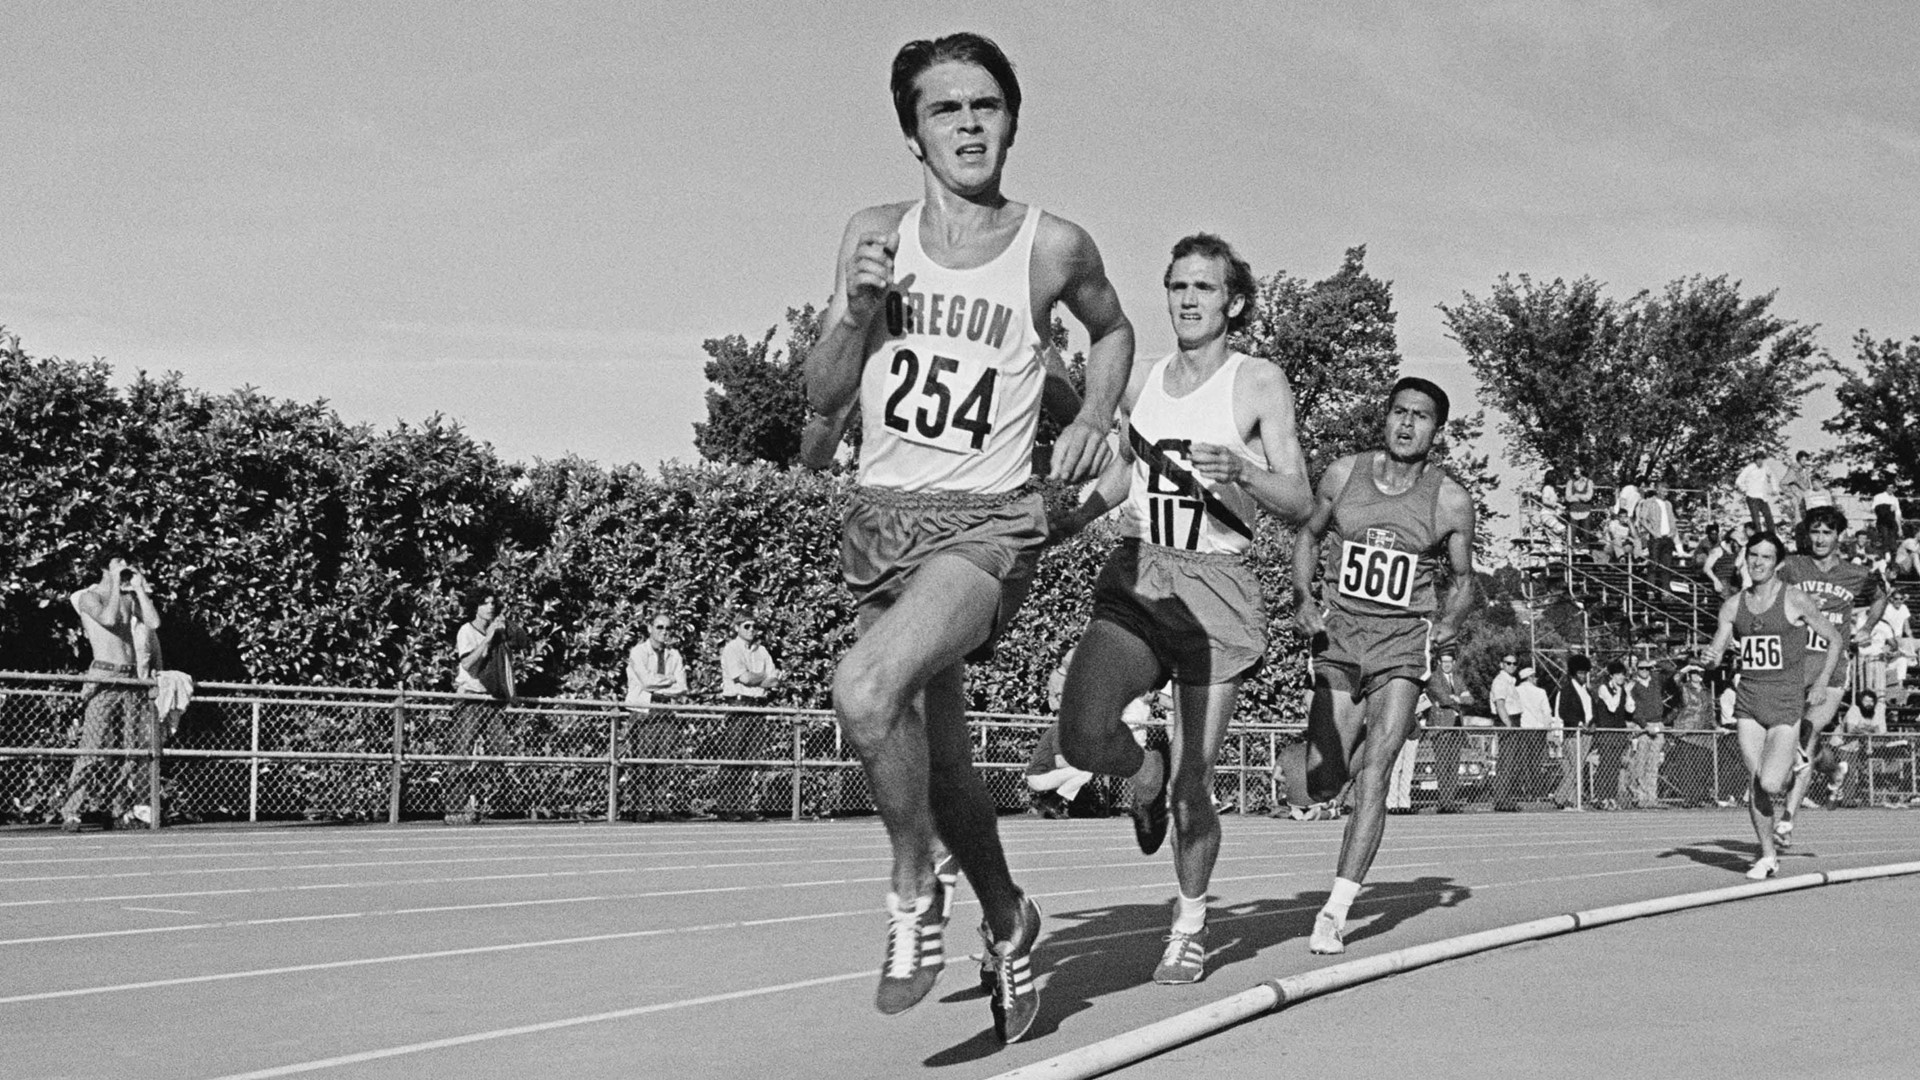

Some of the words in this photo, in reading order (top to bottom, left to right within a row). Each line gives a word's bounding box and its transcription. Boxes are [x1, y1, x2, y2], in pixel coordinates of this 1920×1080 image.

[885, 290, 1013, 349] OREGON
[884, 348, 998, 450] 254
[1149, 497, 1204, 550] 117
[1344, 545, 1410, 601] 560
[1742, 637, 1781, 668] 456
